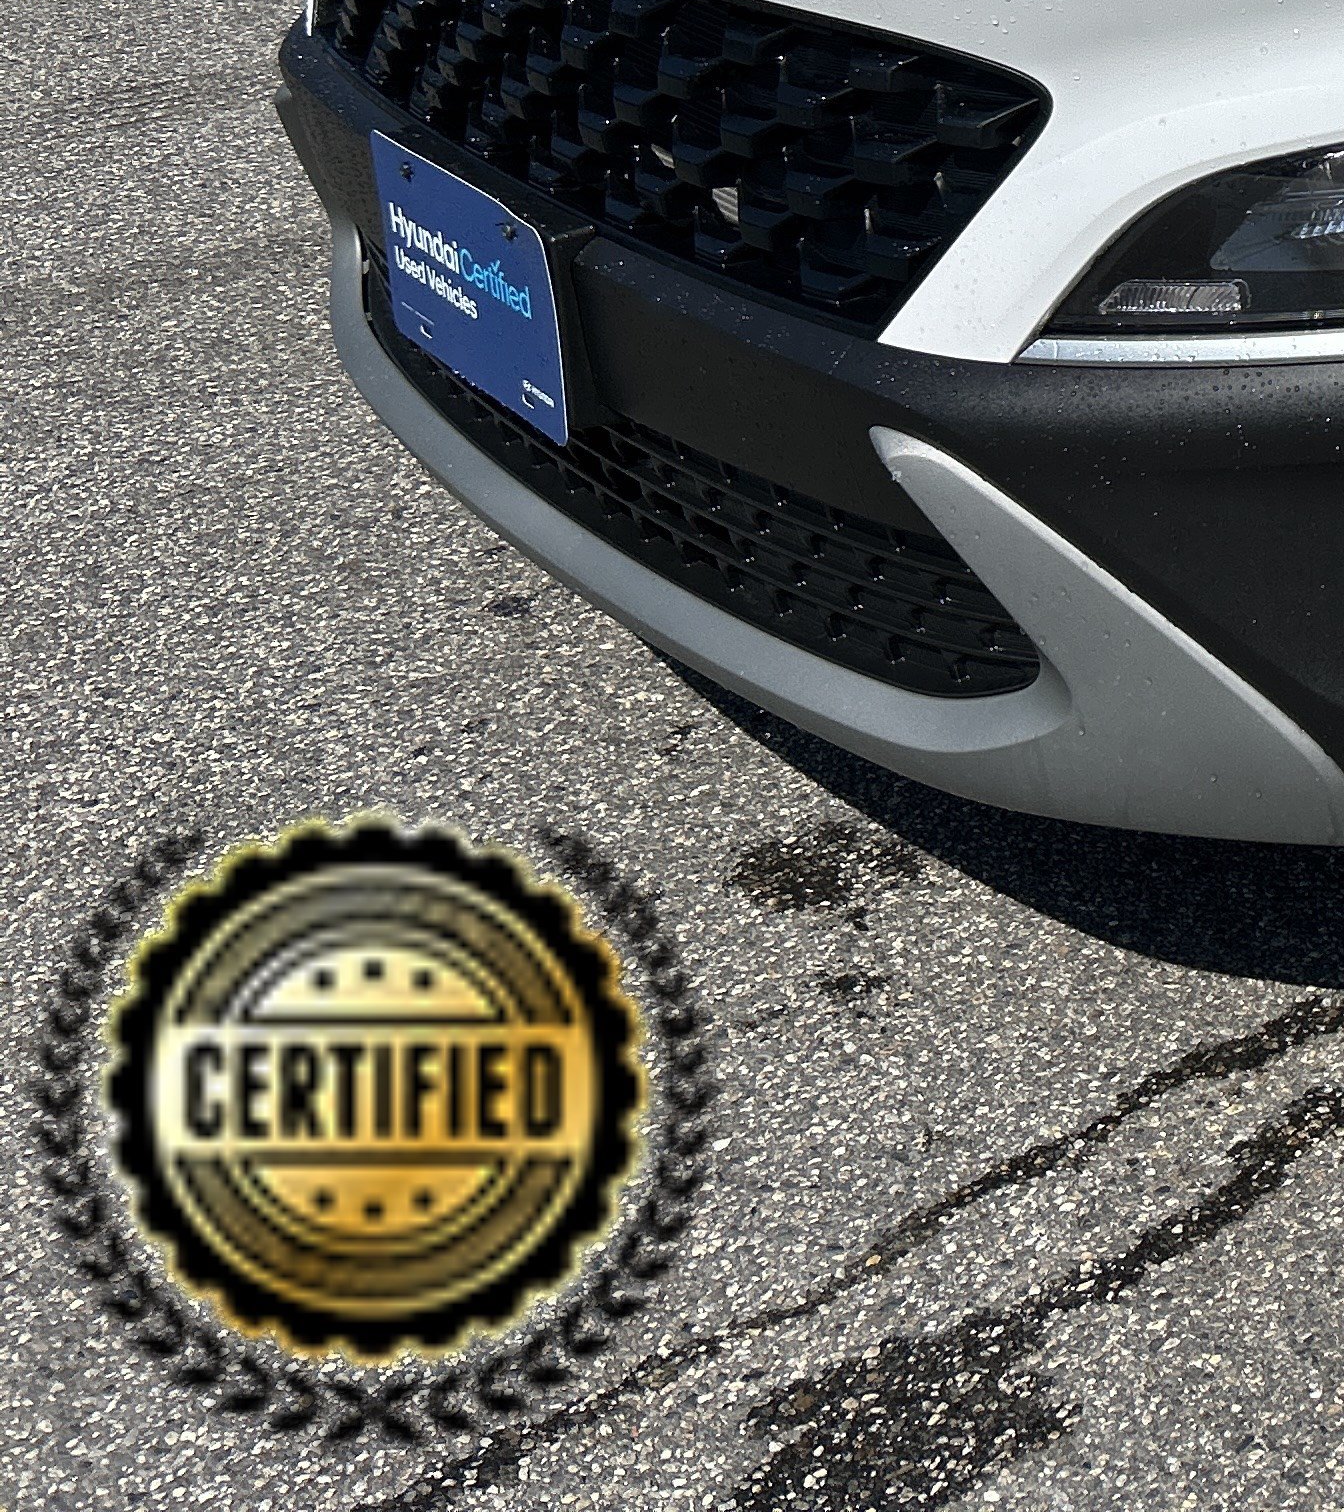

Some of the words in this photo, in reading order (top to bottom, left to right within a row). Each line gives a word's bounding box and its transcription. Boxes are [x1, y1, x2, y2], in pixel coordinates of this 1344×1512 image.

[389, 201, 460, 275] Hyundai
[460, 248, 532, 320] Certified
[394, 245, 426, 285] Used
[425, 265, 478, 320] Vehicles
